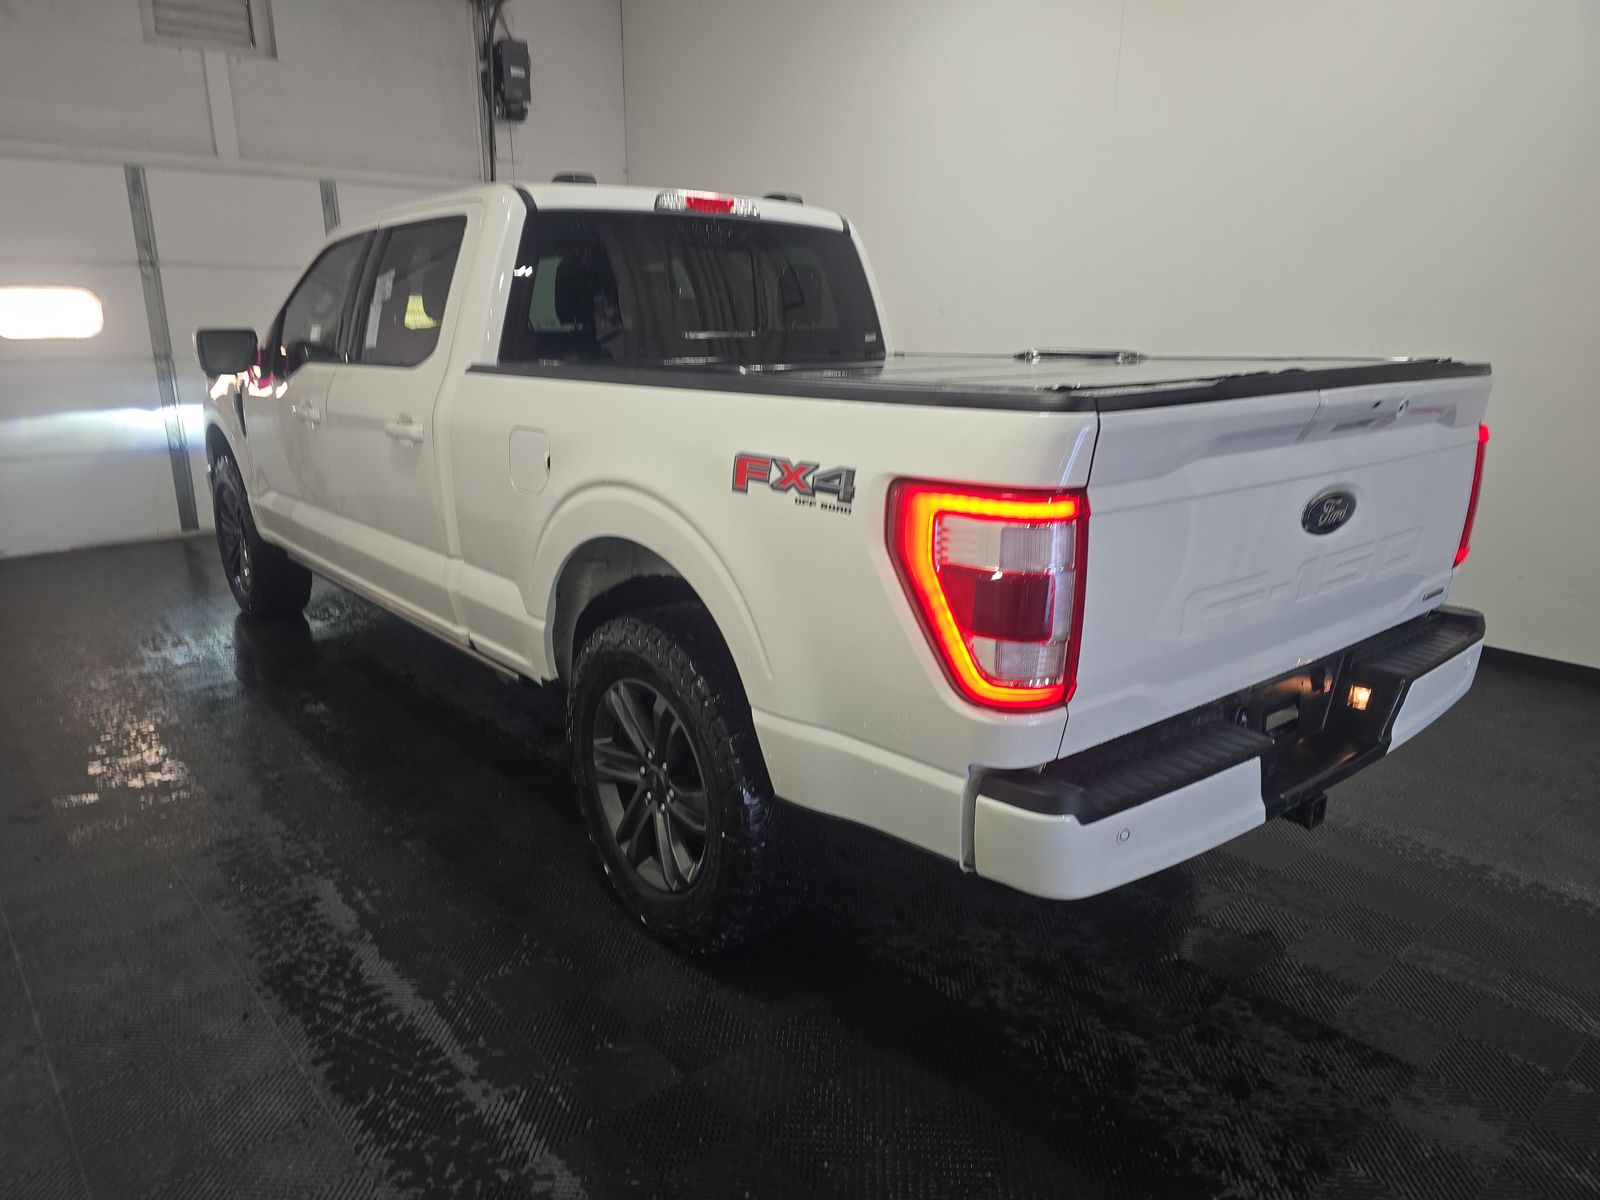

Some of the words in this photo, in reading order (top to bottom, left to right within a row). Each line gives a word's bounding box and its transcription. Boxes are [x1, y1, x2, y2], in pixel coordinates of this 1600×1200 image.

[732, 452, 856, 504] FX4
[1319, 498, 1350, 526] Ford
[1178, 526, 1423, 640] F-150
